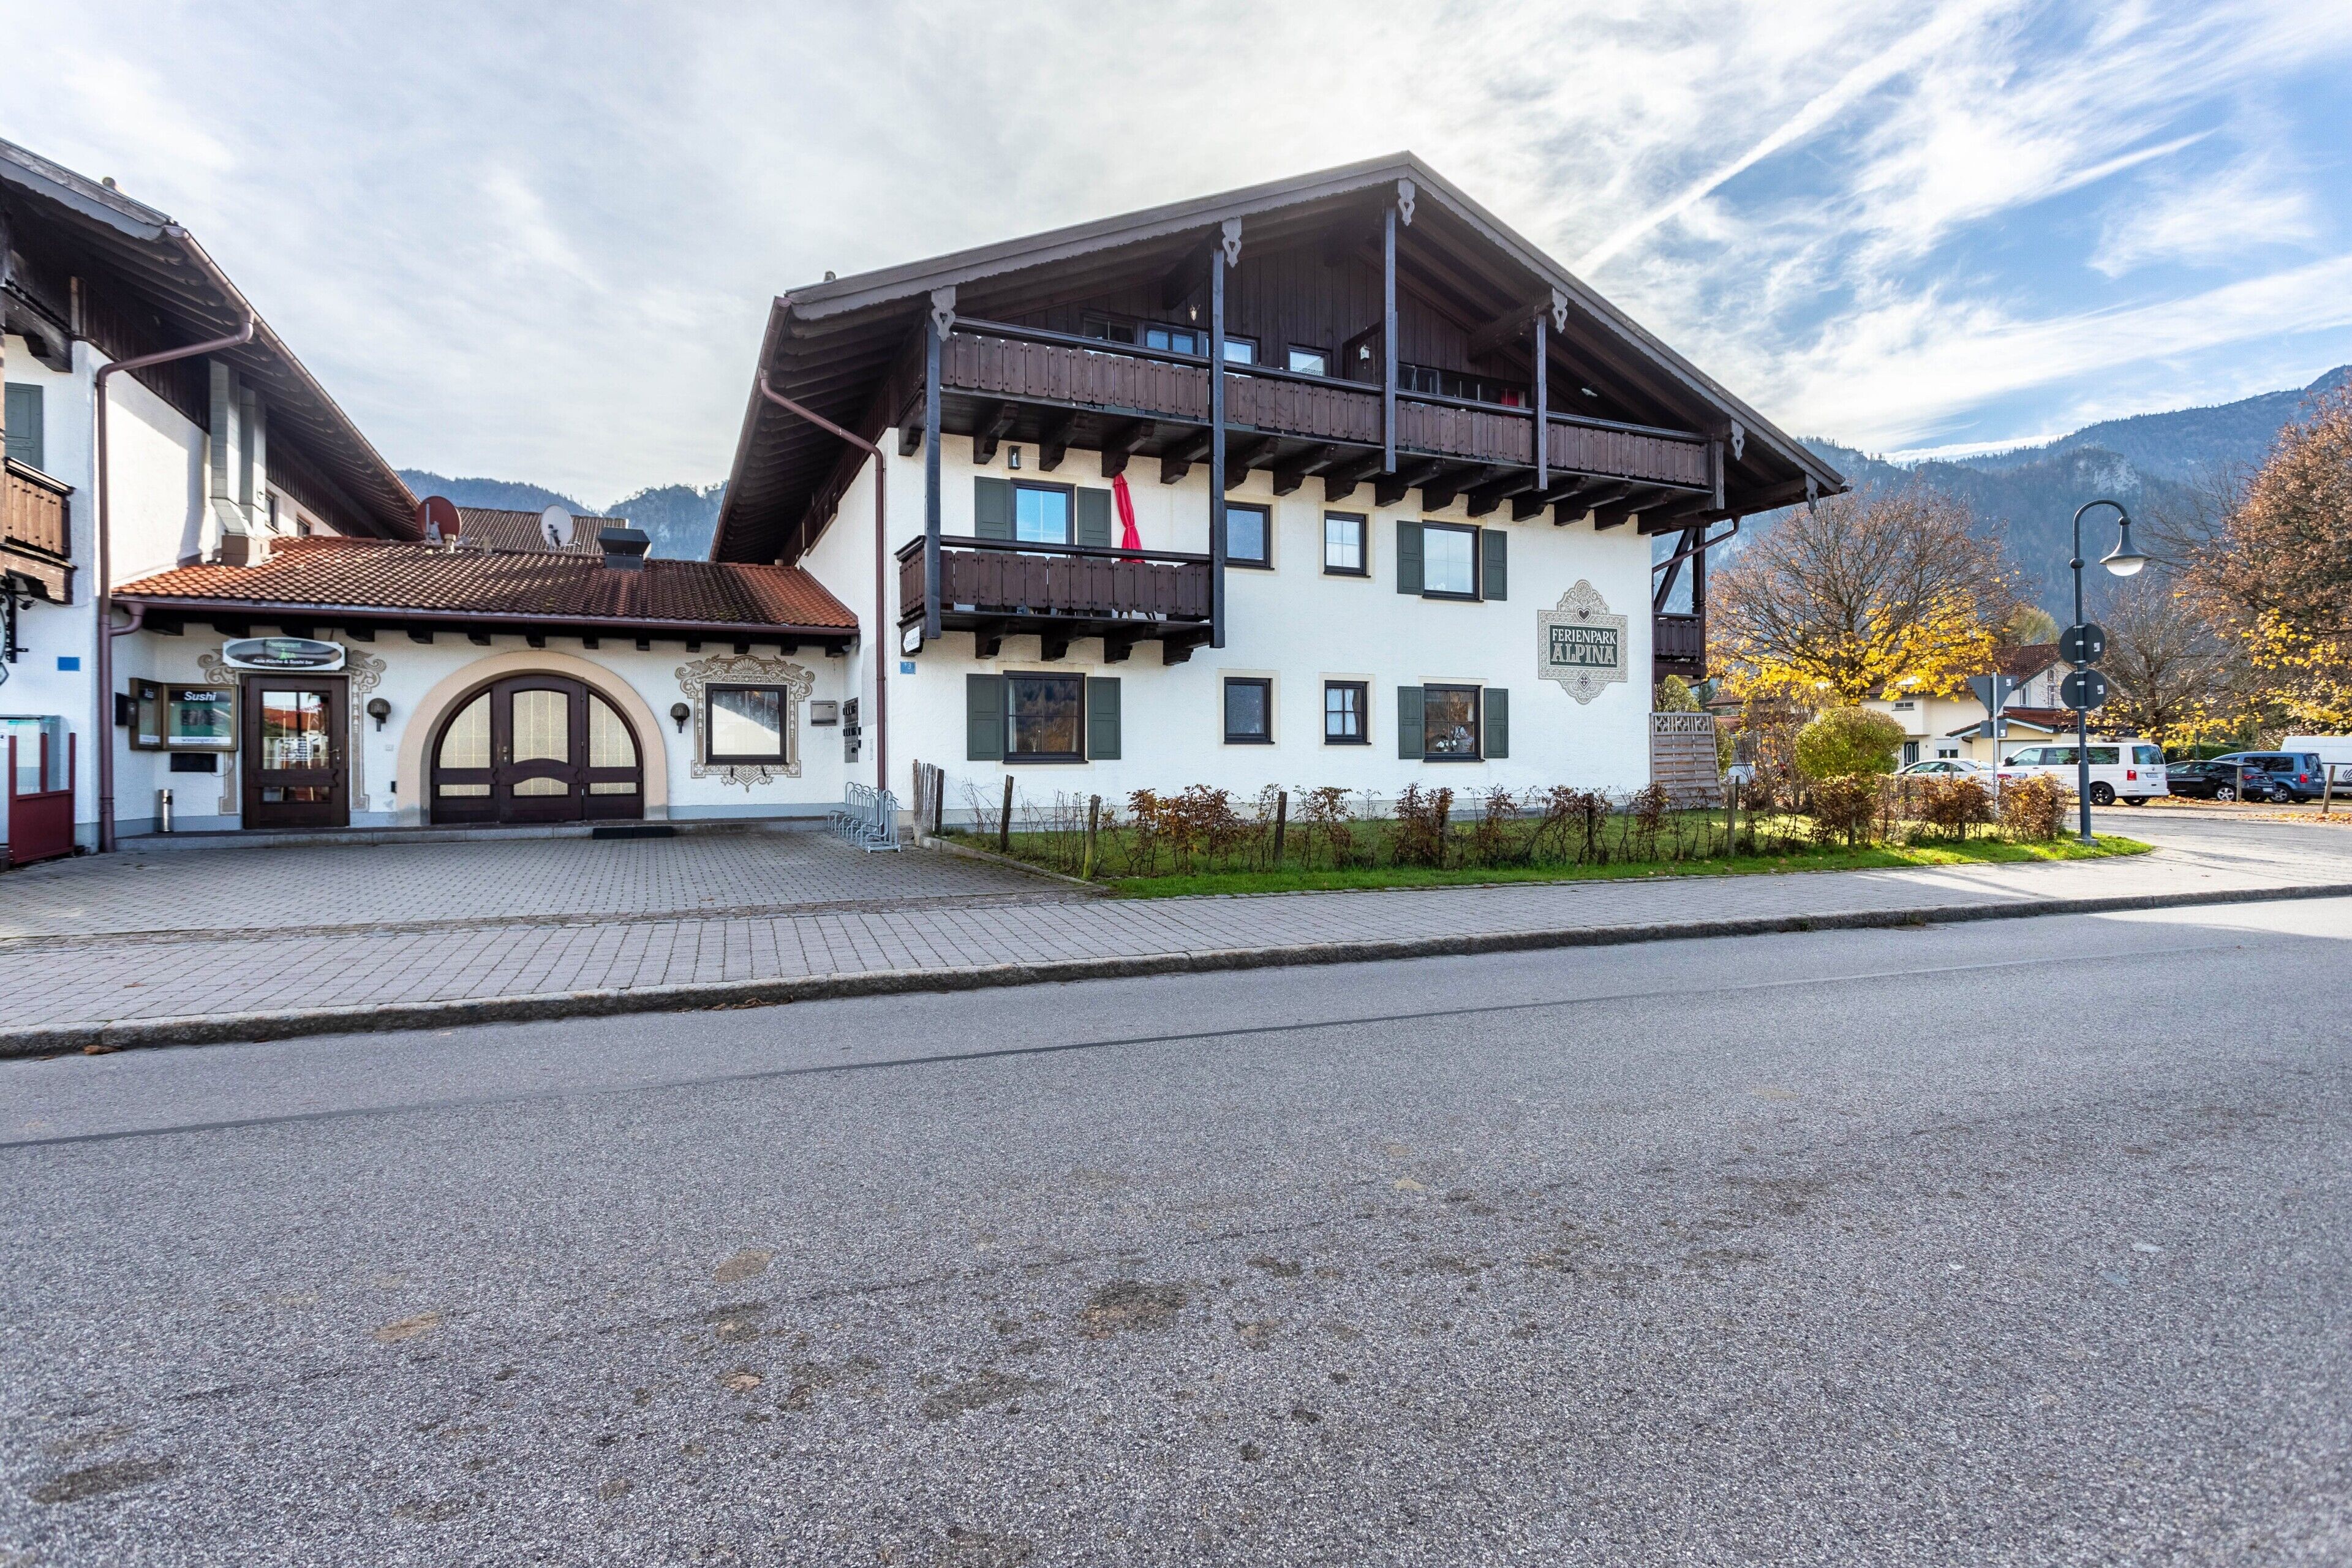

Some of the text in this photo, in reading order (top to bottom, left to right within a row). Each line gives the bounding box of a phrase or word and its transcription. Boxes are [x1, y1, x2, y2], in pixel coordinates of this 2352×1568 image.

[1552, 628, 1616, 644] FERIENPARK
[1551, 643, 1616, 665] ALPINA
[184, 692, 216, 701] Sushi
